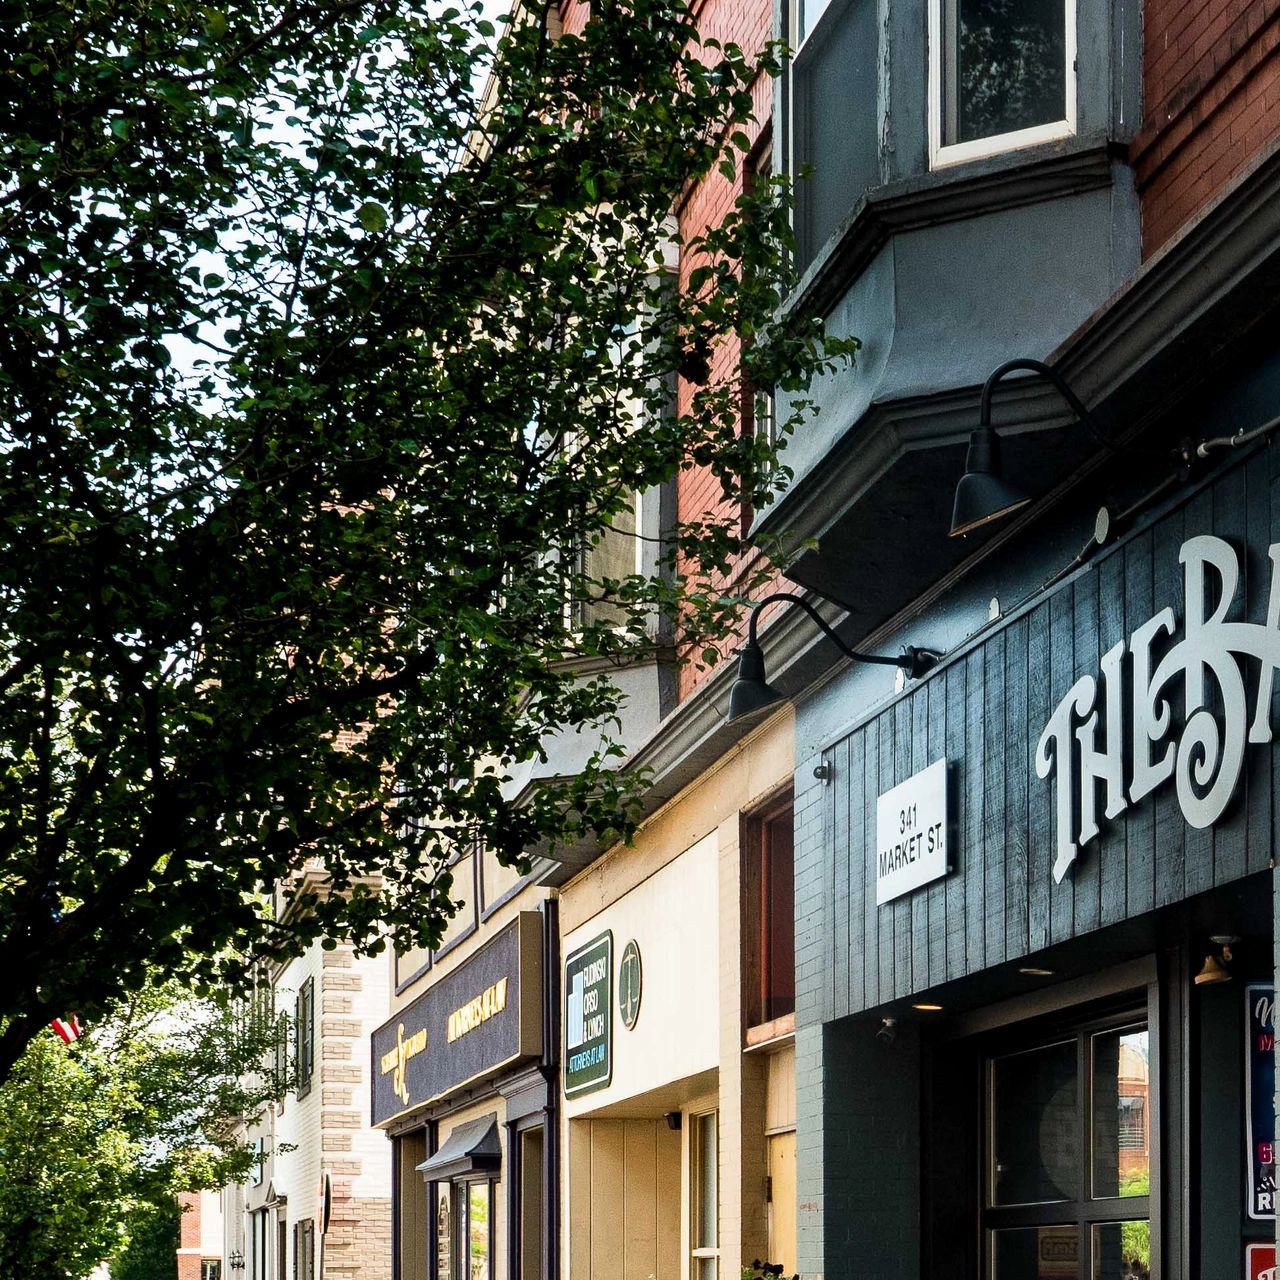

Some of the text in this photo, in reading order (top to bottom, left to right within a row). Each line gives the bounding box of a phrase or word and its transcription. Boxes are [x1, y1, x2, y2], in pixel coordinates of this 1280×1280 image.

[1035, 606, 1176, 884] THE
[899, 803, 917, 834] 341
[879, 822, 943, 878] MARKET ST.
